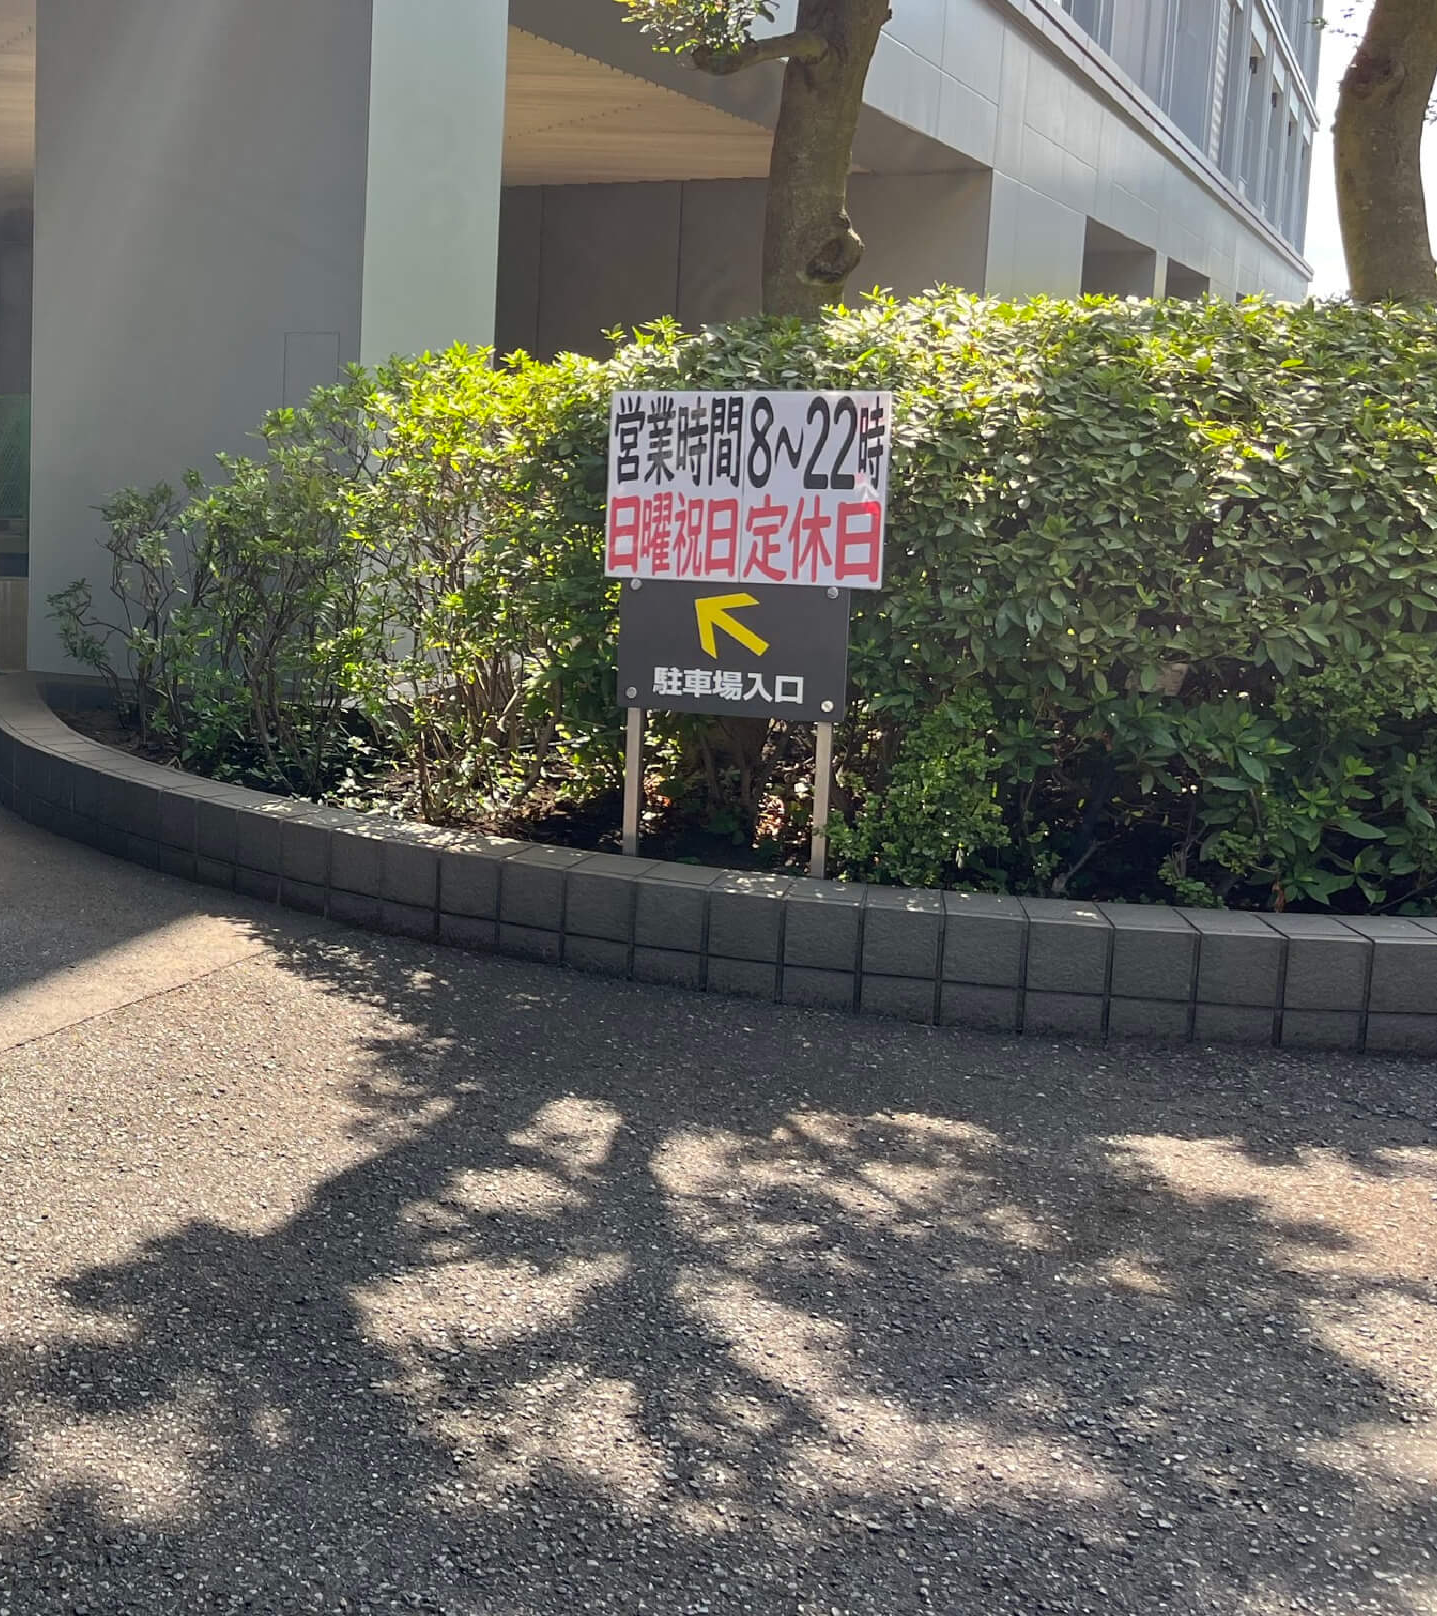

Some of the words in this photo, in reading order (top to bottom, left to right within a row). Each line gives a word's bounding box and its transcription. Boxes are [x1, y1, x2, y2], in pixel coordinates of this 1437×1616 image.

[607, 492, 882, 583] 日曜祝日定休日
[652, 667, 804, 705] 駐車場入口
